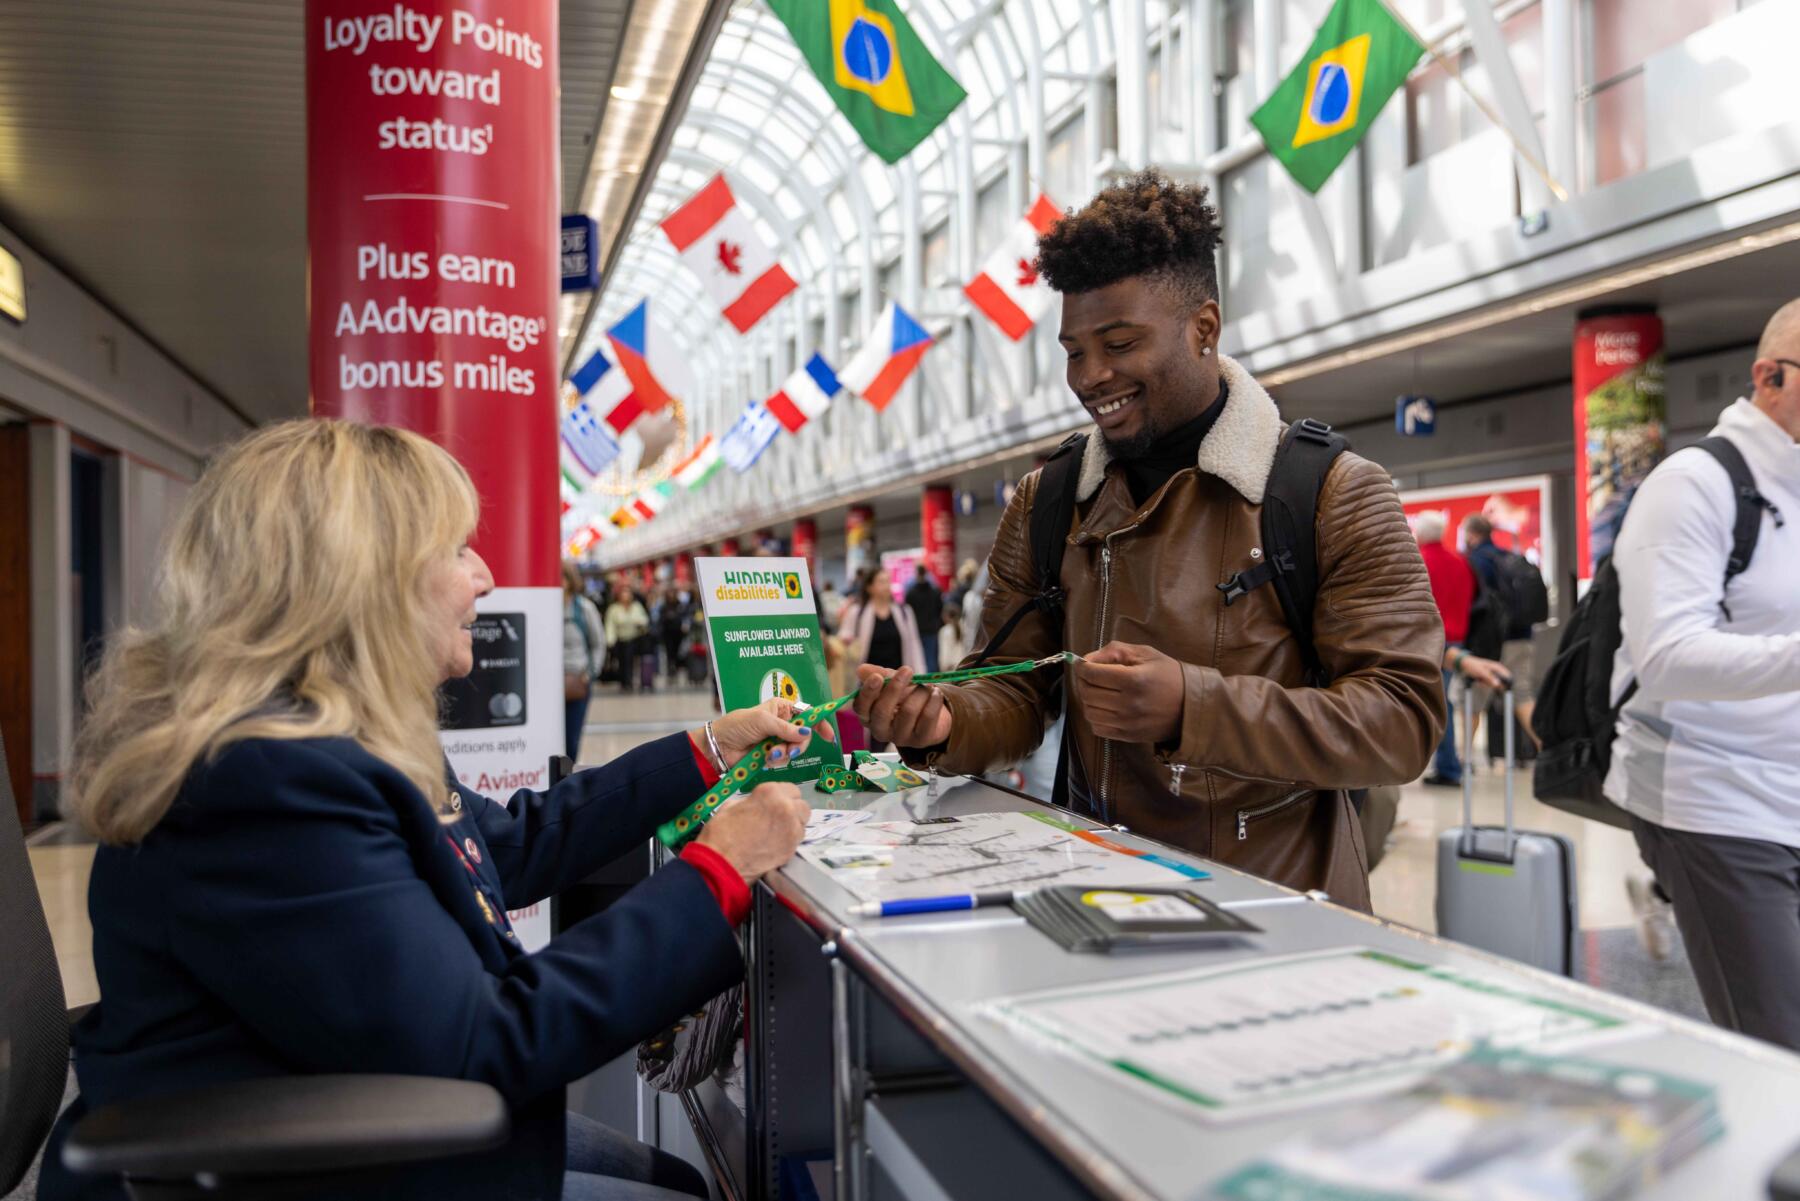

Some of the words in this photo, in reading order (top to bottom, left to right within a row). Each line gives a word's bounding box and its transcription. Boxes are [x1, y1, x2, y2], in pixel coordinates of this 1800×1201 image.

[325, 3, 442, 55] Loyalty
[452, 9, 543, 69] Points
[369, 64, 500, 105] toward
[358, 242, 429, 281] Plus
[438, 254, 515, 288] earn
[340, 354, 443, 391] bonus
[454, 356, 536, 396] miles
[724, 571, 783, 588] HIDDEN
[716, 585, 780, 600] disabilities
[724, 629, 774, 642] SUNFLOWER
[775, 627, 811, 640] LANYARD
[739, 645, 783, 659] AVAILABLE
[783, 643, 805, 656] HERE
[443, 740, 495, 754] nditions
[497, 738, 527, 754] apply
